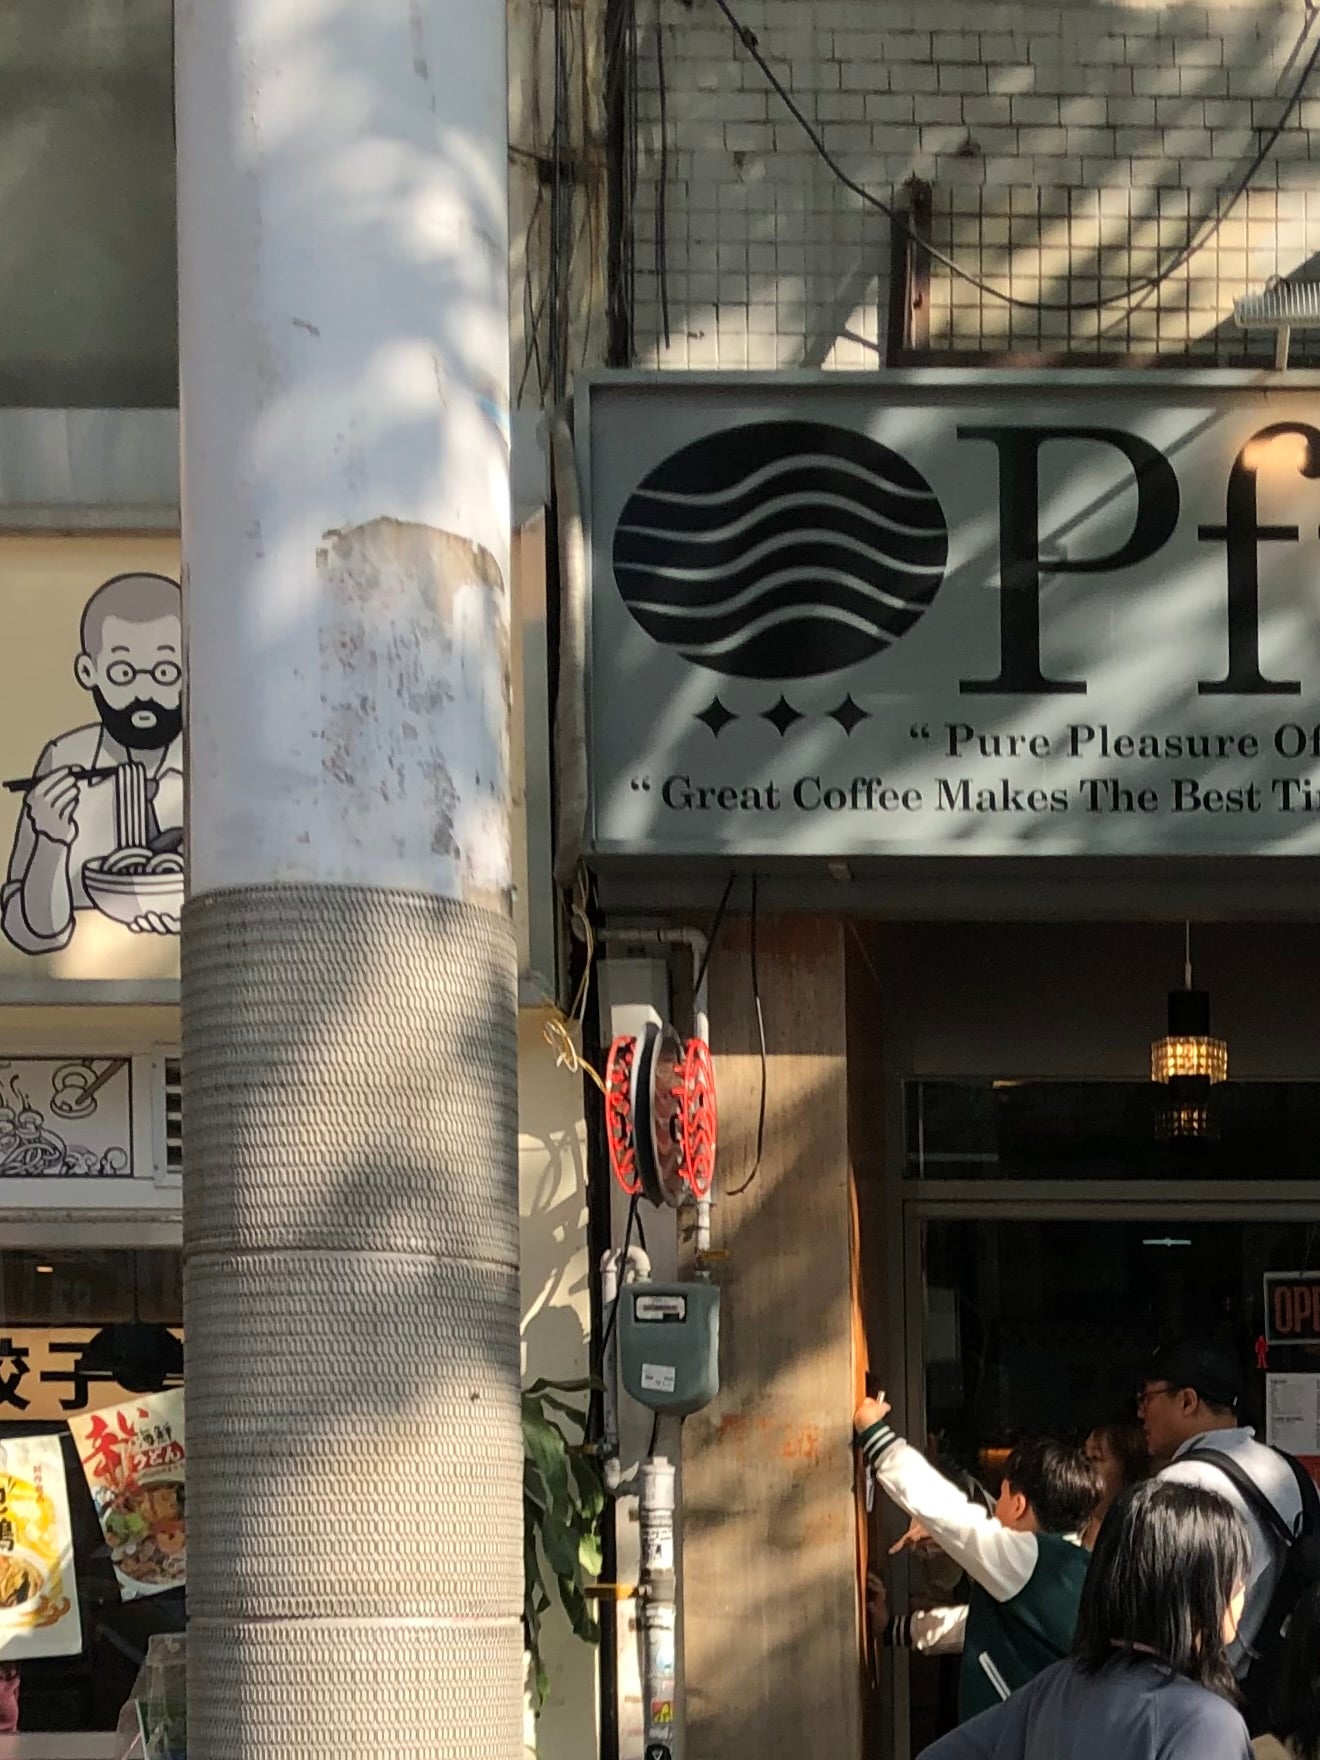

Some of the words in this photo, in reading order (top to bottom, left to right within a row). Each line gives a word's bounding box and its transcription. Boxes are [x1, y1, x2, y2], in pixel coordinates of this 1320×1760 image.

[1066, 722, 1259, 758] Pleasure
[792, 777, 922, 814] Coffee
[934, 778, 1069, 813] Makes
[1080, 778, 1160, 813] The
[1171, 778, 1261, 813] Best
